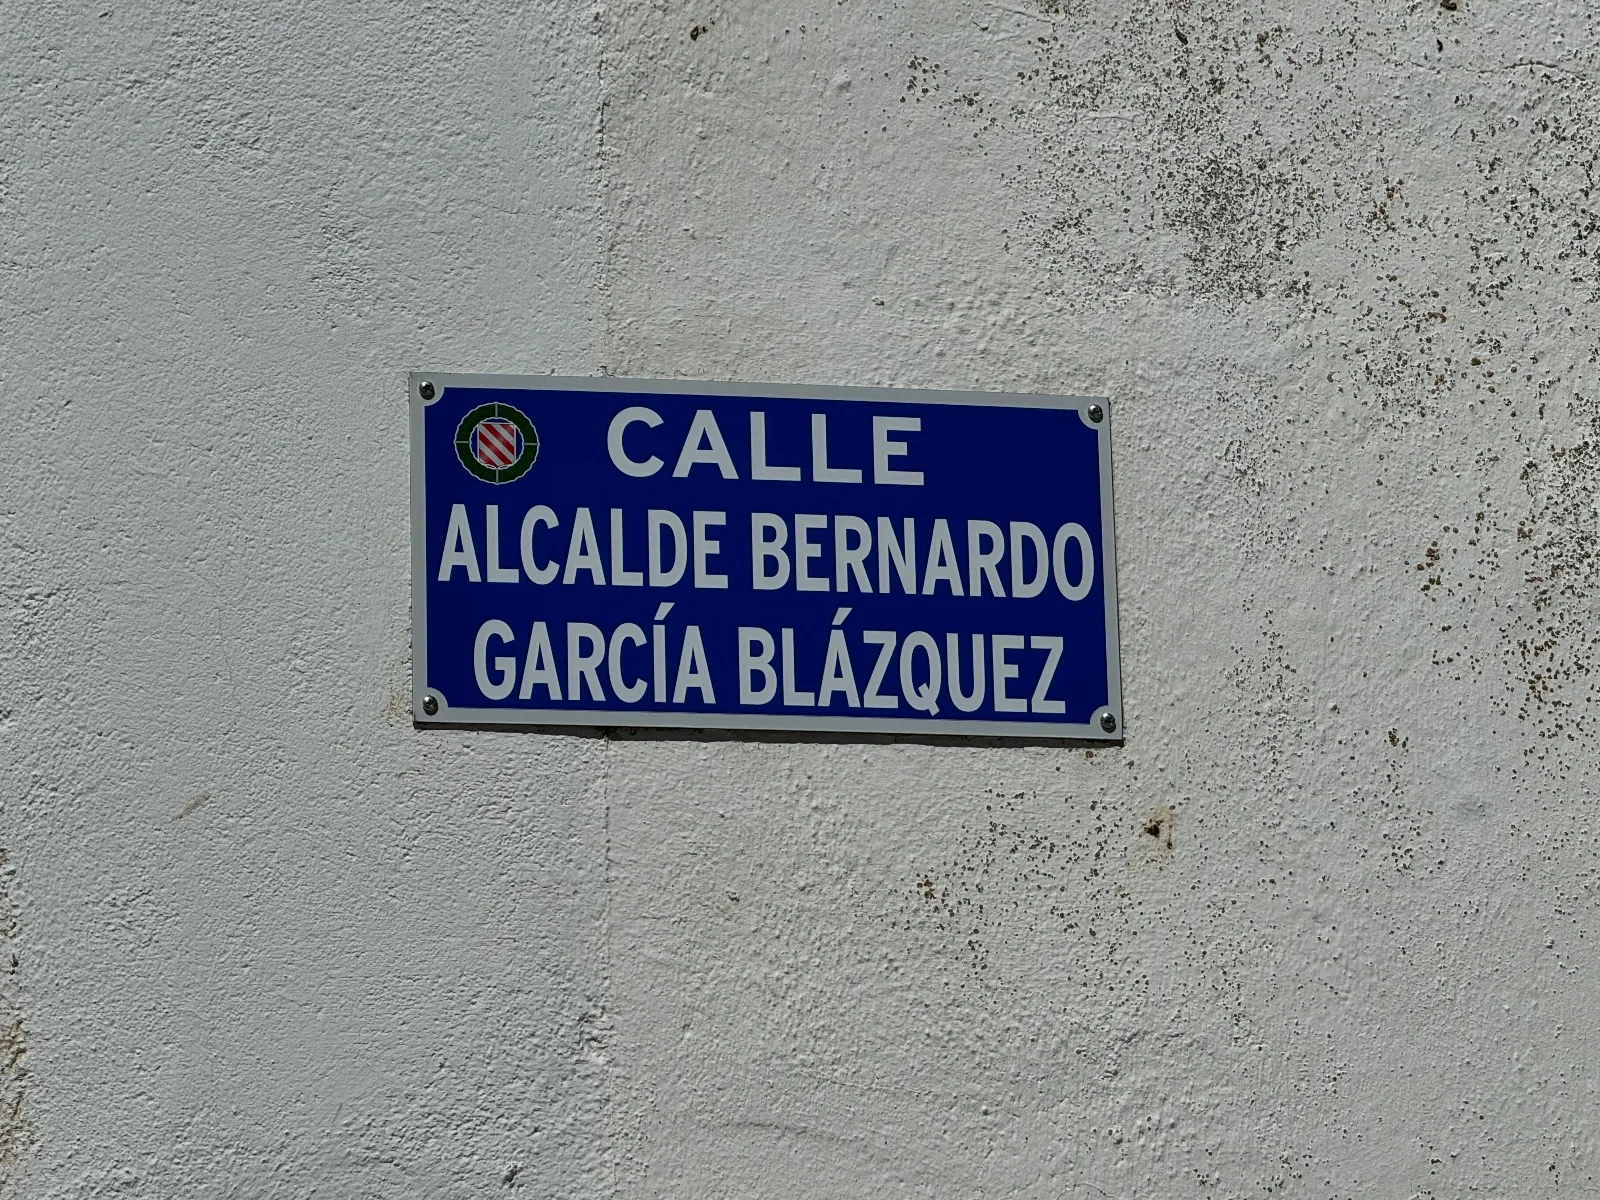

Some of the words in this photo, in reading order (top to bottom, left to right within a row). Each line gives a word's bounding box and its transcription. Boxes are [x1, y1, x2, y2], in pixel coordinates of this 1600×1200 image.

[607, 406, 925, 486] CALLE
[437, 503, 729, 590] ALCALDE
[751, 512, 1095, 602] BERNARDO
[473, 601, 717, 704] GARCÍA
[738, 607, 1066, 717] BLÁZQUEZ
